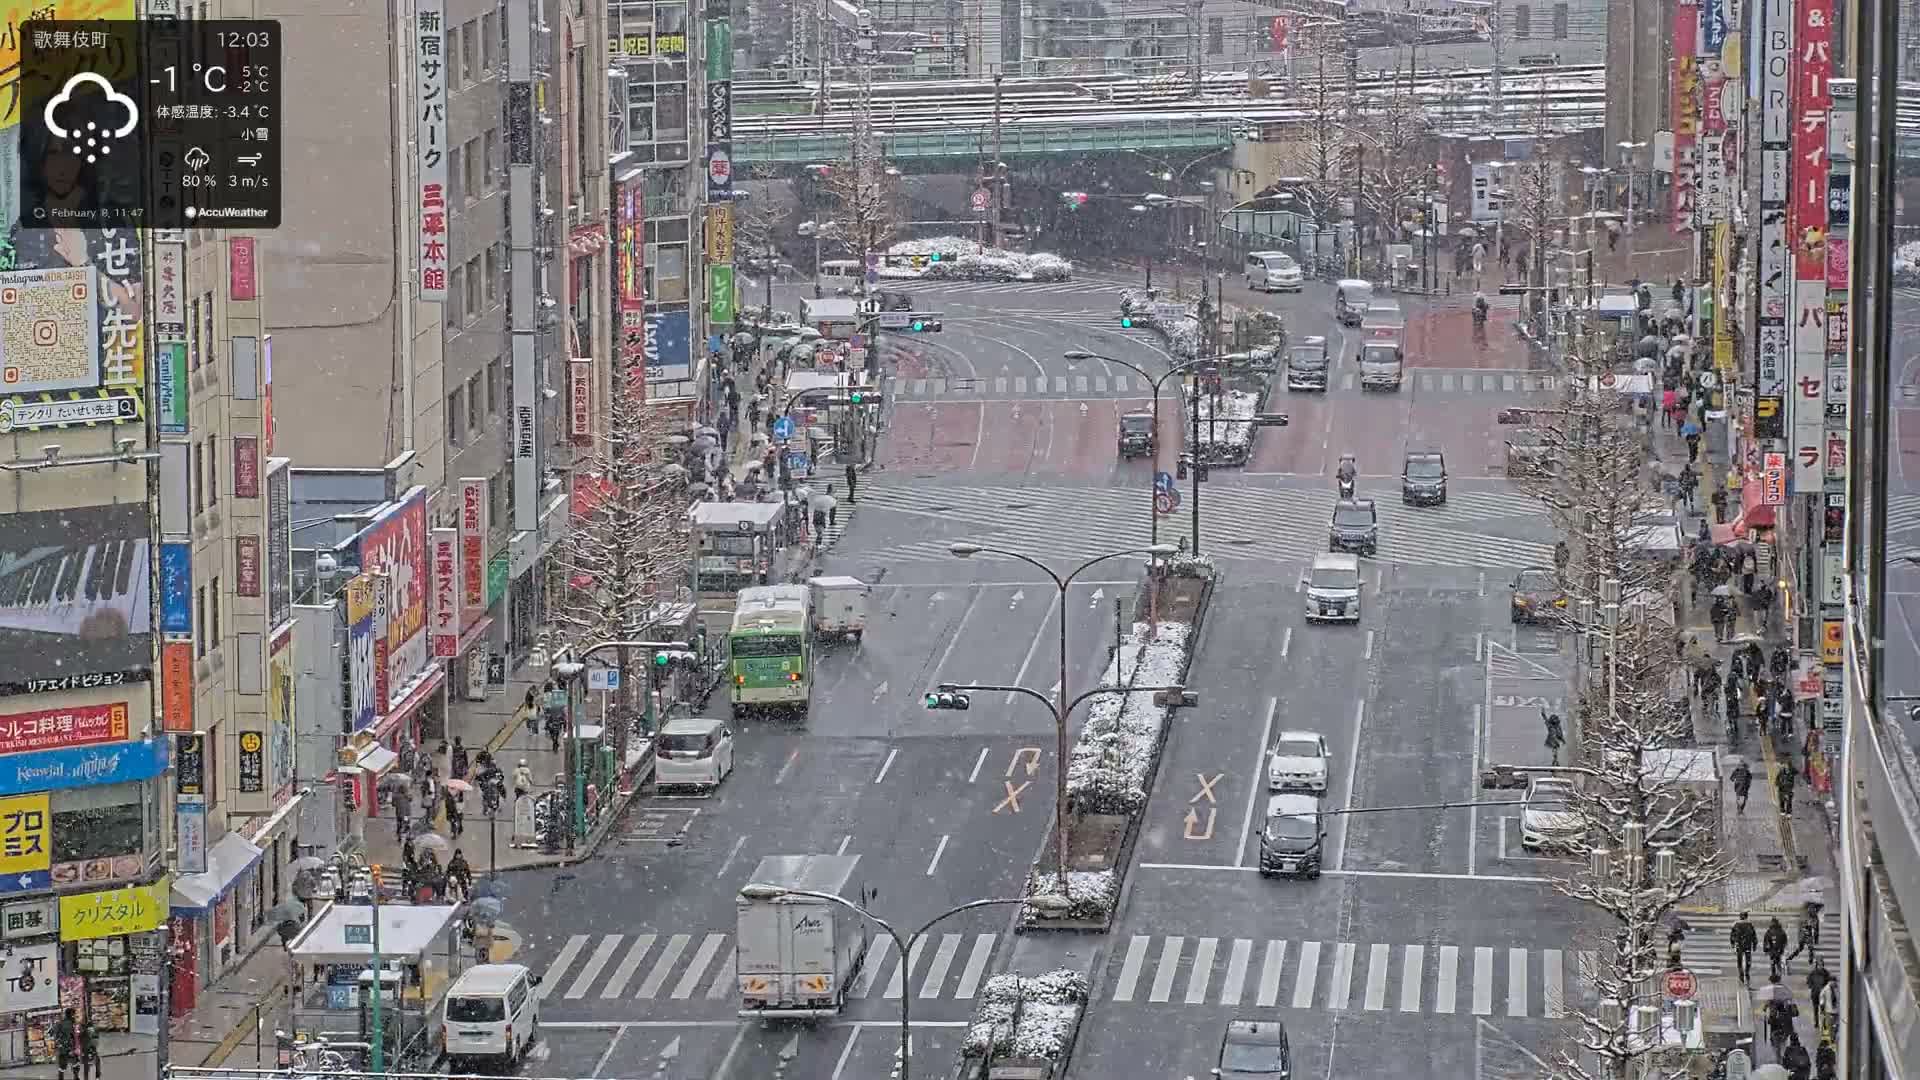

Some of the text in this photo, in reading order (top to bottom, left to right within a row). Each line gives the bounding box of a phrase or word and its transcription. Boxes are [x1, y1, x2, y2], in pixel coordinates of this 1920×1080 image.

[419, 11, 447, 290] 新宿サンパーク 三平本館
[712, 160, 729, 176] 薬
[1763, 328, 1776, 381] 大衆酒場
[160, 353, 173, 413] FamilyMart
[1798, 307, 1823, 468] パセラ
[58, 404, 115, 417] たいせい先生
[519, 406, 531, 458] HOMEGAME
[464, 486, 476, 530] GAME
[377, 579, 386, 617] 389
[28, 673, 124, 692] リアエイドビジョン
[4, 809, 43, 833] プロ
[5, 835, 43, 856] ミス
[7, 910, 43, 930] 囲碁
[73, 902, 144, 925] クリスタル
